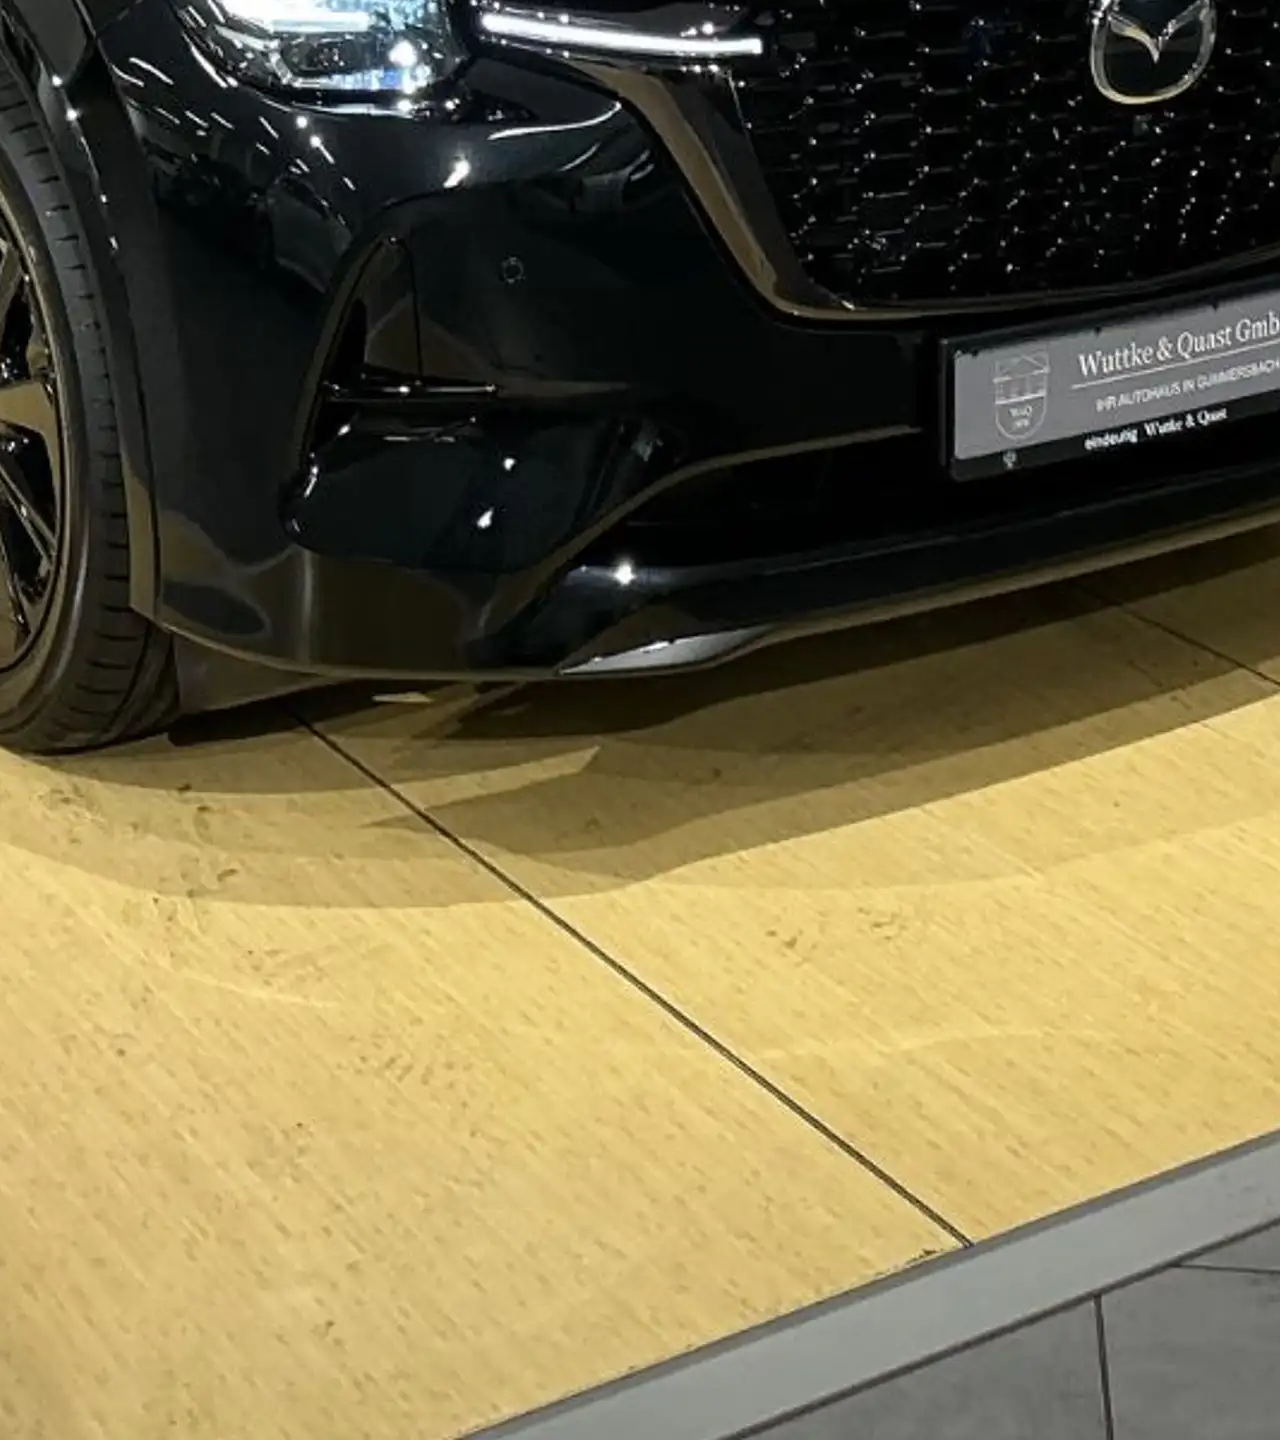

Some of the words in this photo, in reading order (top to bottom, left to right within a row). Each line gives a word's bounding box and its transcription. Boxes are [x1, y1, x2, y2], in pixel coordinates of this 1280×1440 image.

[1078, 341, 1153, 378] Wuttke
[1156, 336, 1173, 362] &
[1177, 326, 1233, 359] Quast
